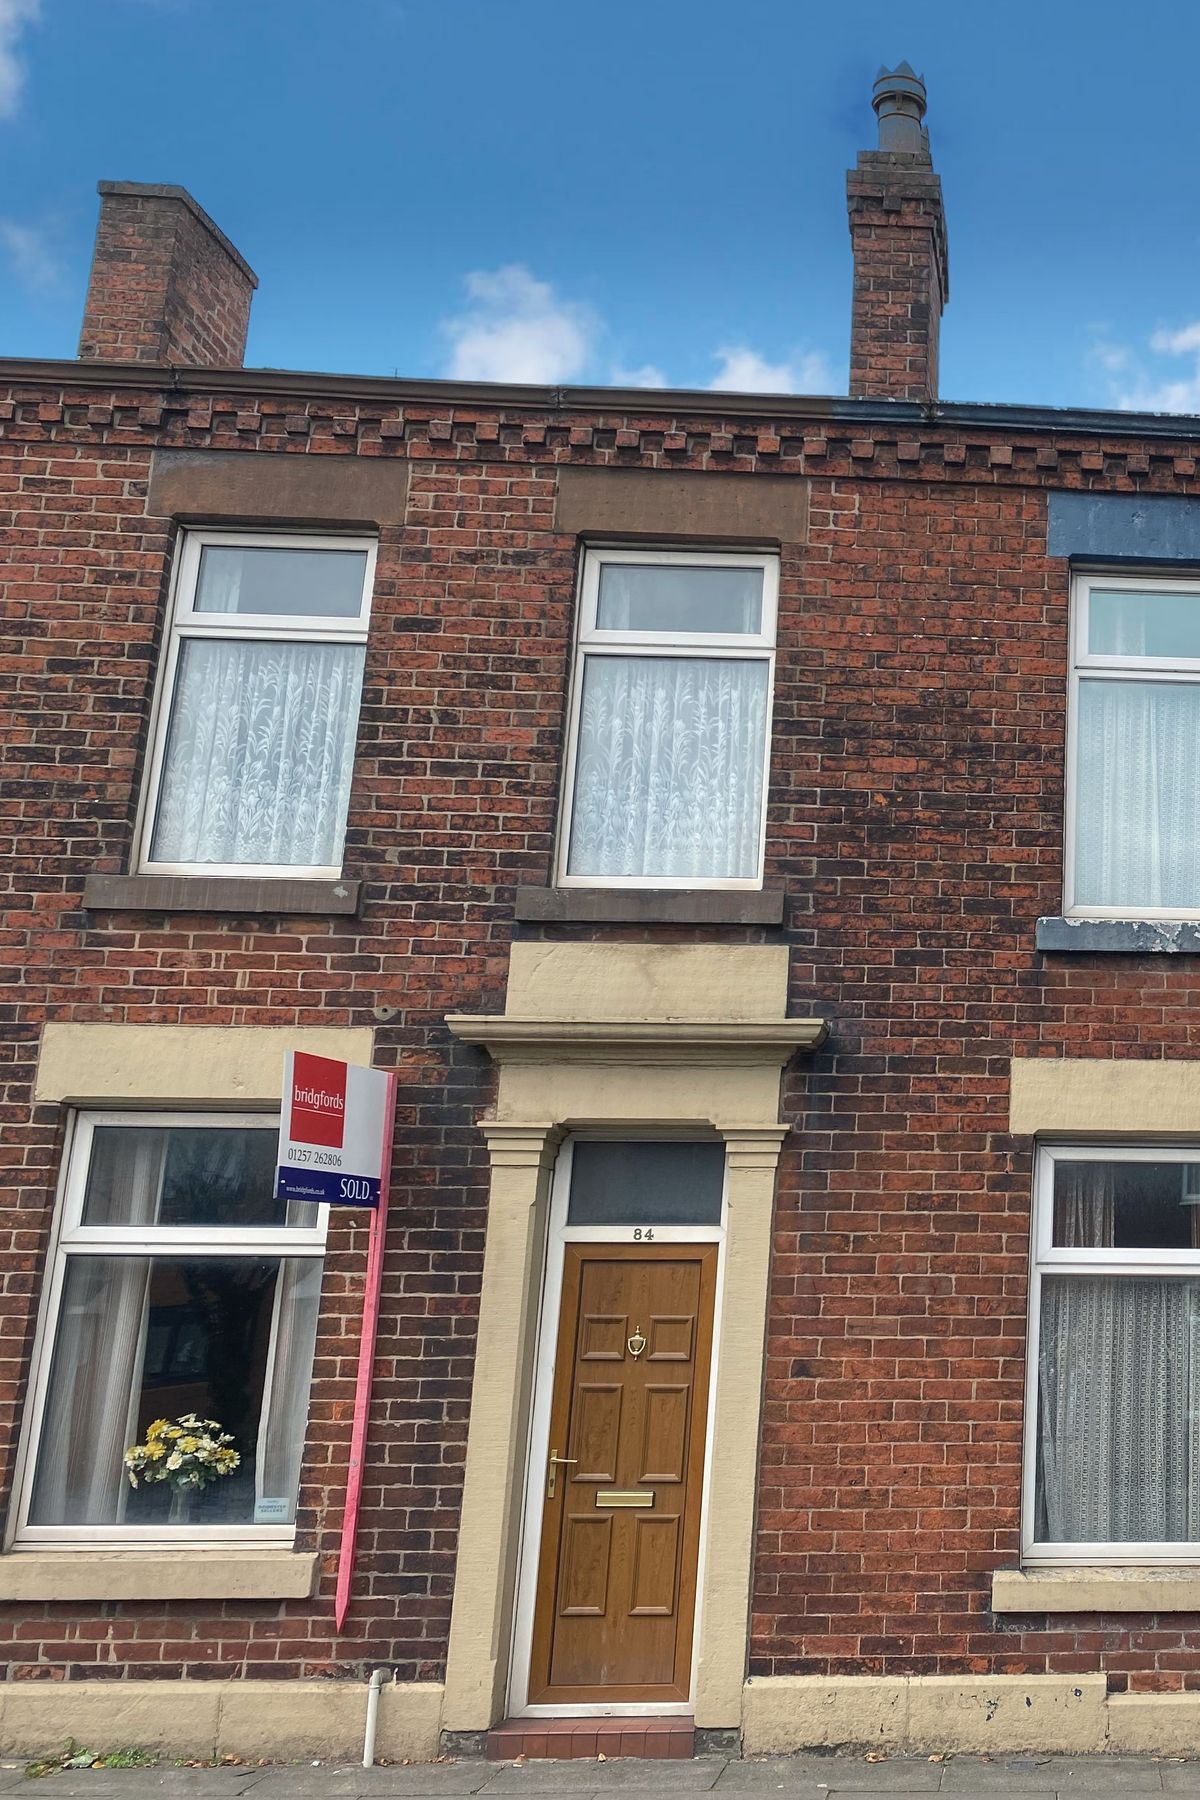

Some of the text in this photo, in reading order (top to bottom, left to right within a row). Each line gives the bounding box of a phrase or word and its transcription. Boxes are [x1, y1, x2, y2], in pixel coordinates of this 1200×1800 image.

[294, 1085, 344, 1110] bridgfords
[288, 1148, 342, 1167] 01257 262806
[340, 1178, 370, 1200] SOLD
[633, 1228, 655, 1241] 84
